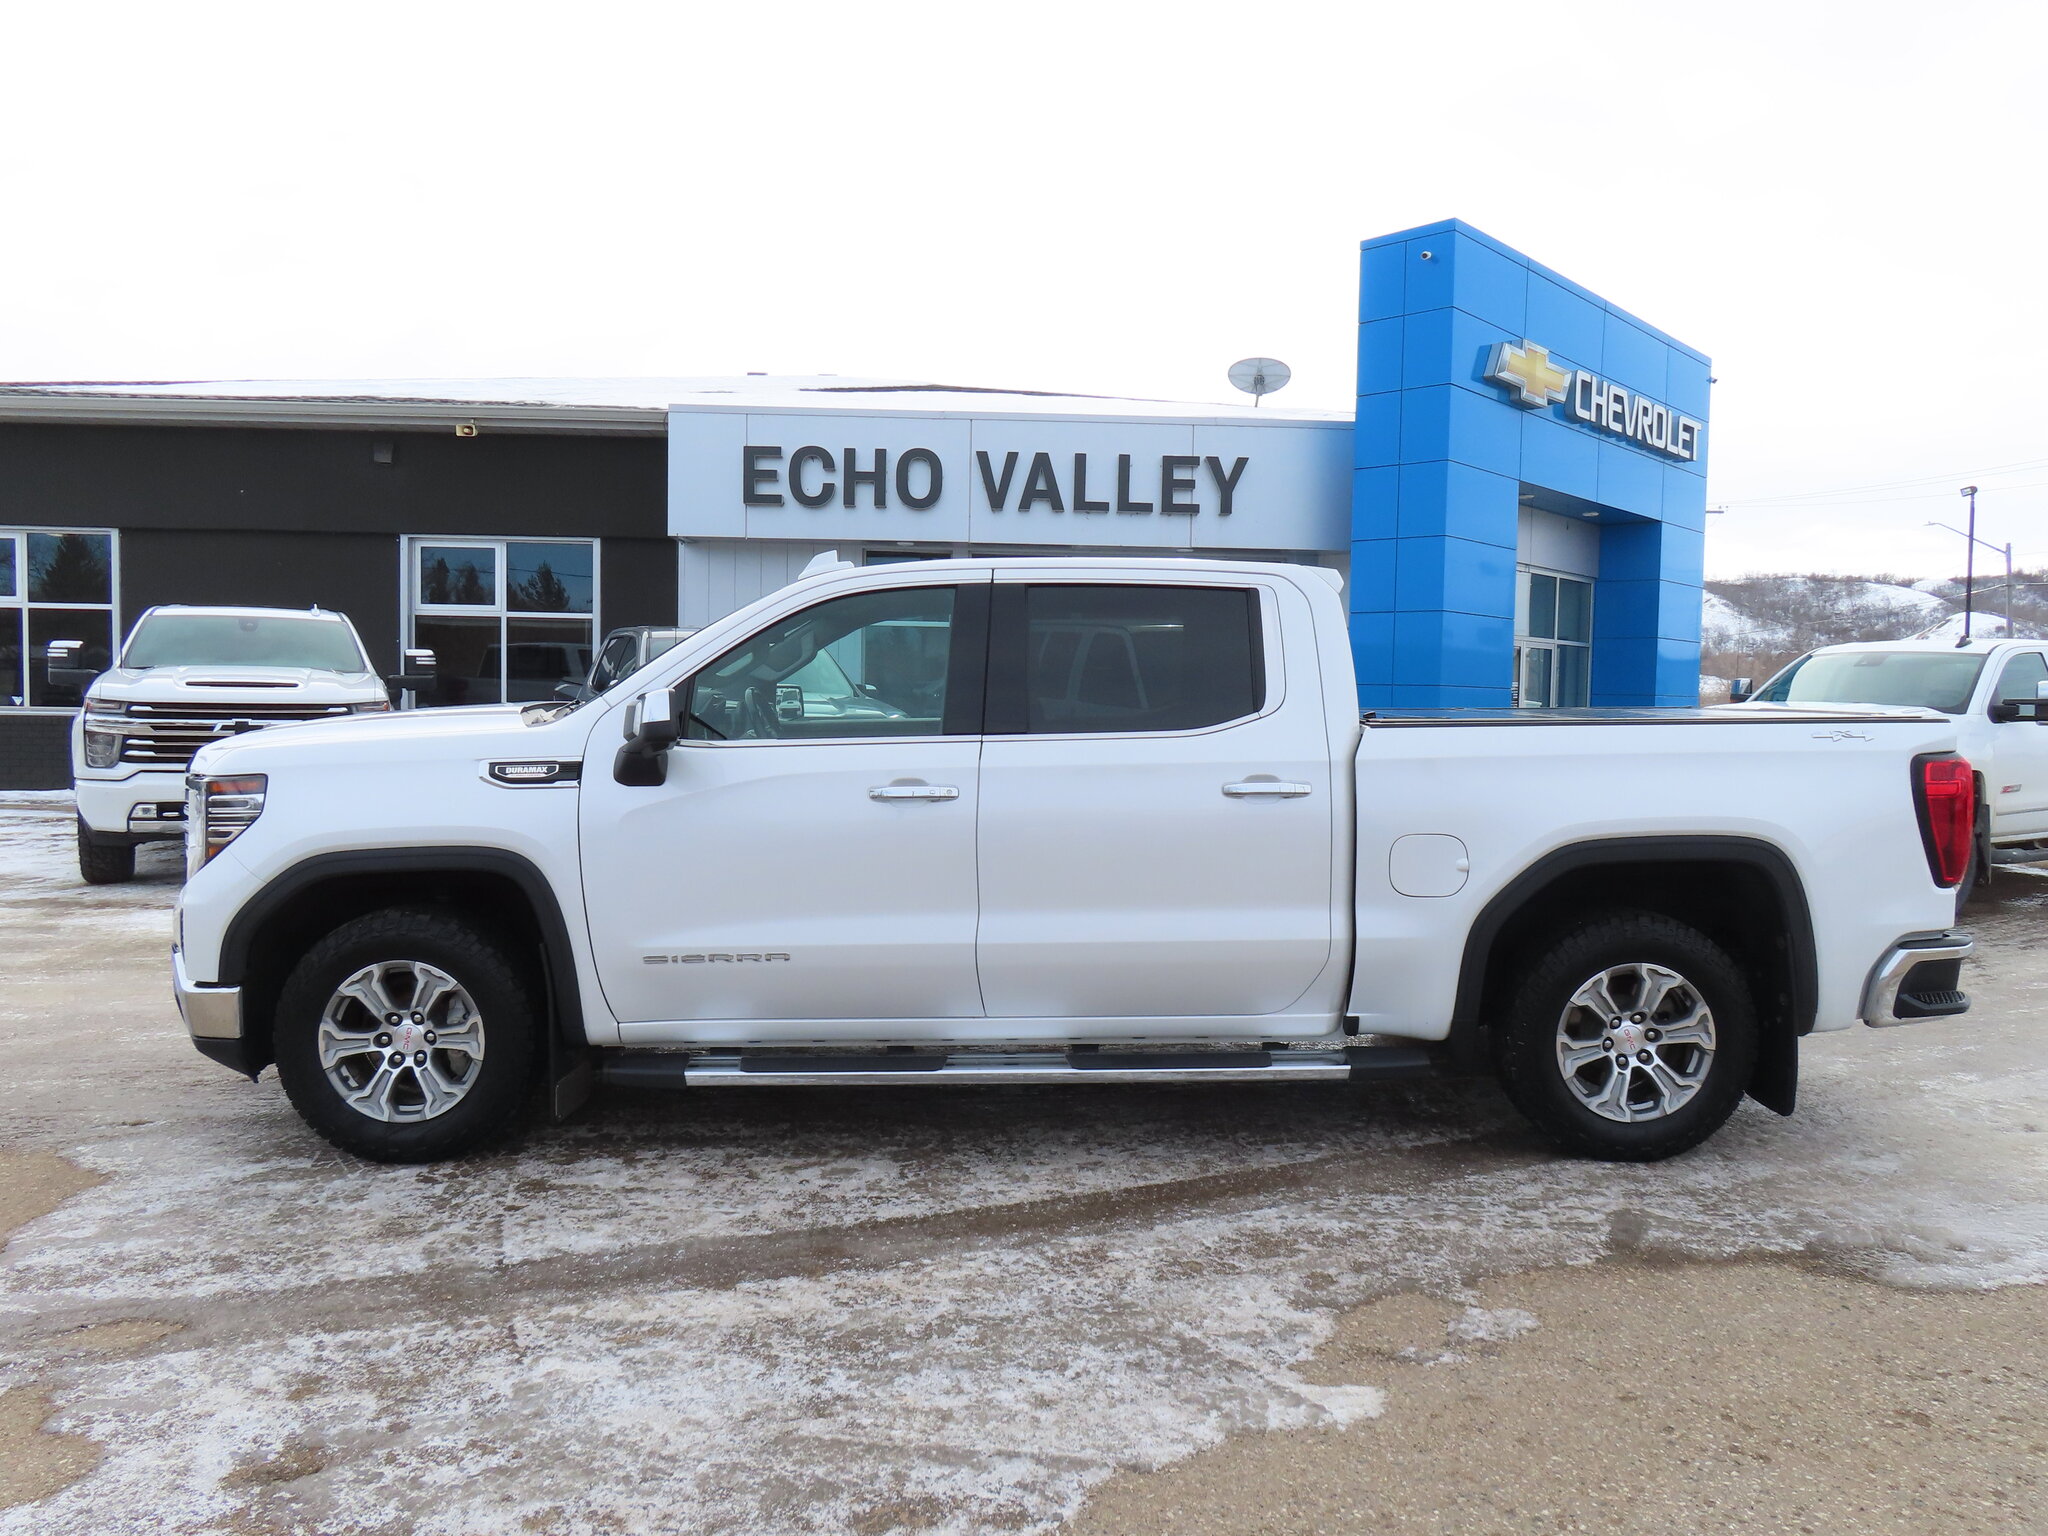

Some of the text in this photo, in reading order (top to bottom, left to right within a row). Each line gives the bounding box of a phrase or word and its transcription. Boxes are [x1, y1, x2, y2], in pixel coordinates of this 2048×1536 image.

[1574, 369, 1702, 461] CHEVROLET
[742, 445, 1250, 518] ECHO VALLEY
[505, 766, 549, 774] DURAMAX
[643, 952, 791, 964] SIERRA
[403, 1027, 413, 1050] GMC
[1623, 1029, 1636, 1050] GMC
